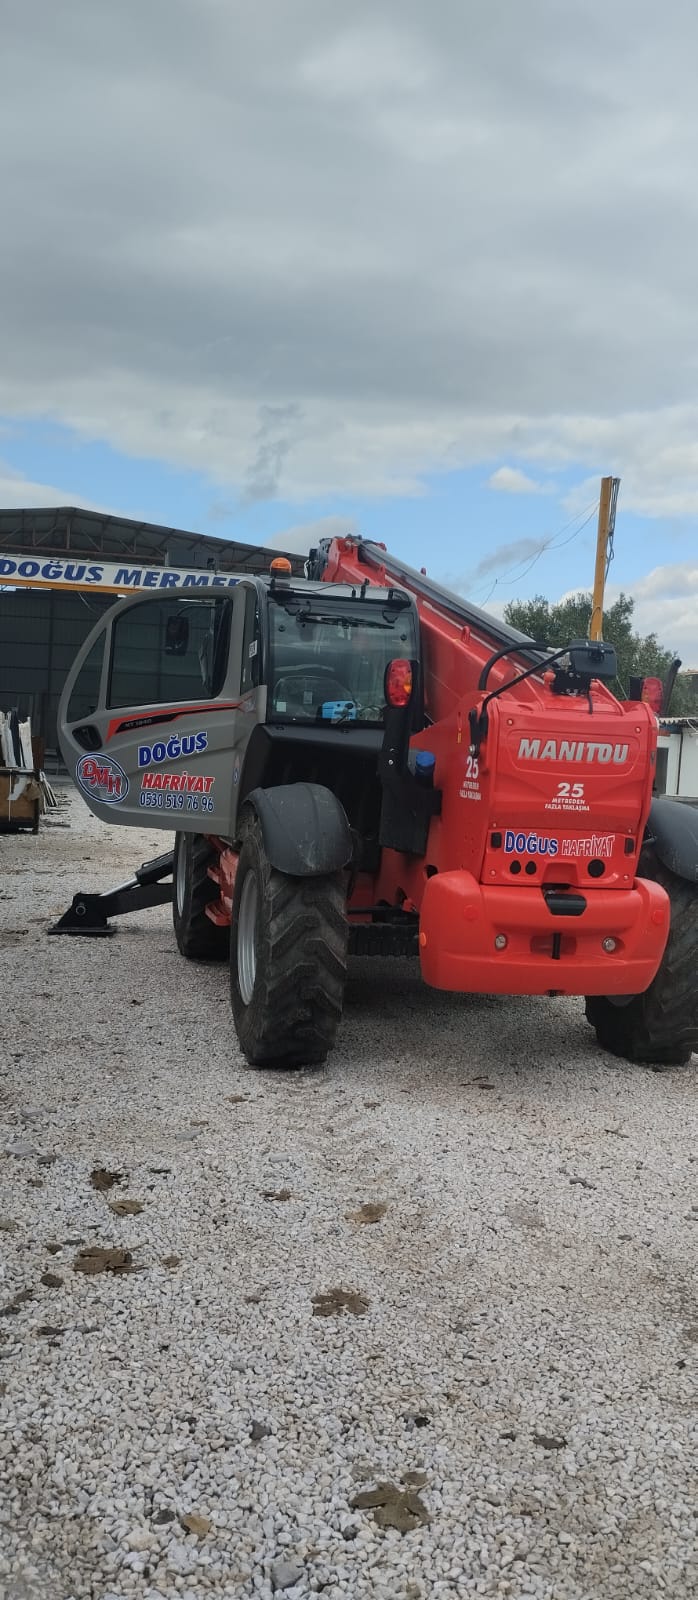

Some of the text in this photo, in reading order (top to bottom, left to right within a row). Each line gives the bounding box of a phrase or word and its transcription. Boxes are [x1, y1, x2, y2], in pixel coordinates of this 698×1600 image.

[0, 559, 104, 584] DOĞUŞ
[137, 731, 208, 767] DOĞUŞ
[517, 738, 629, 764] MANITOU
[465, 755, 479, 779] 25
[141, 771, 215, 794] HAFRİYAT
[556, 782, 585, 797] 25
[140, 792, 214, 812] 0530 519 76 96
[504, 831, 615, 857] DOĞUŞ HAFRİYAT
